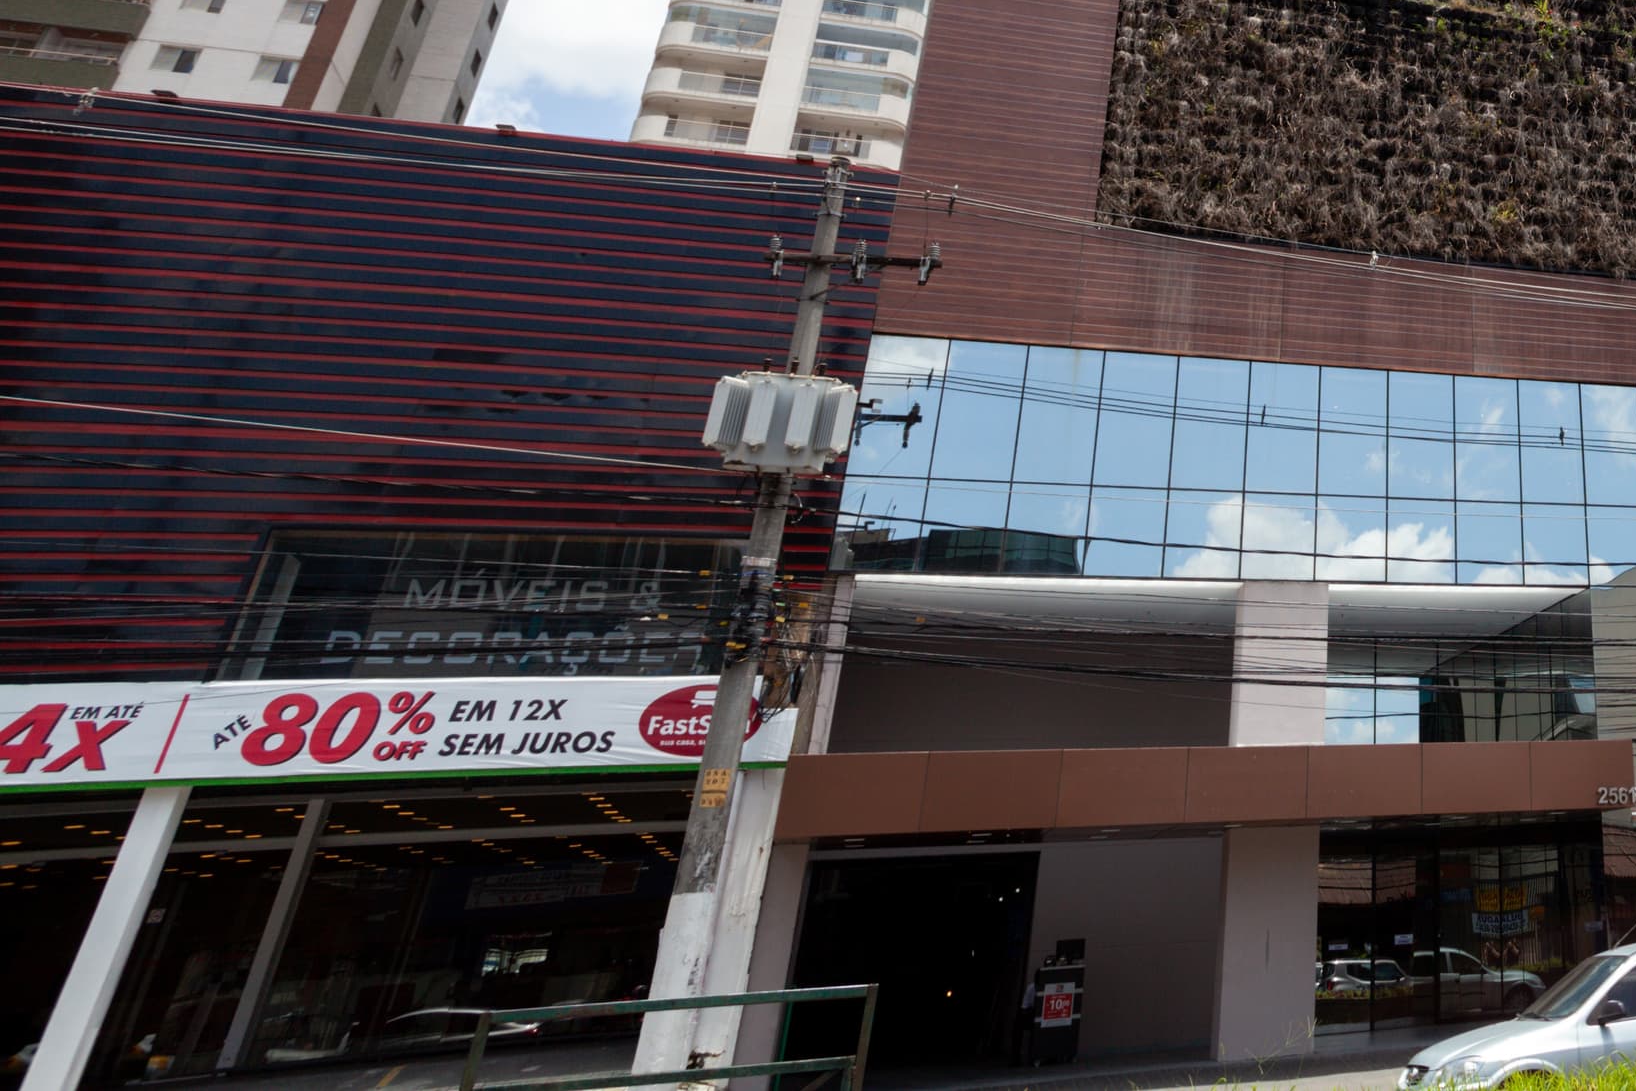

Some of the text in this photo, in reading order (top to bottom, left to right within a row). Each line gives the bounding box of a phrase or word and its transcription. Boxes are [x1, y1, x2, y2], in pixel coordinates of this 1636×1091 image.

[69, 701, 144, 720] EM ATÉ
[448, 699, 568, 722] EM 12X
[212, 714, 252, 750] ATÉ
[241, 691, 436, 766] 80%
[372, 741, 427, 761] OFF
[438, 730, 616, 757] SEM JUROS
